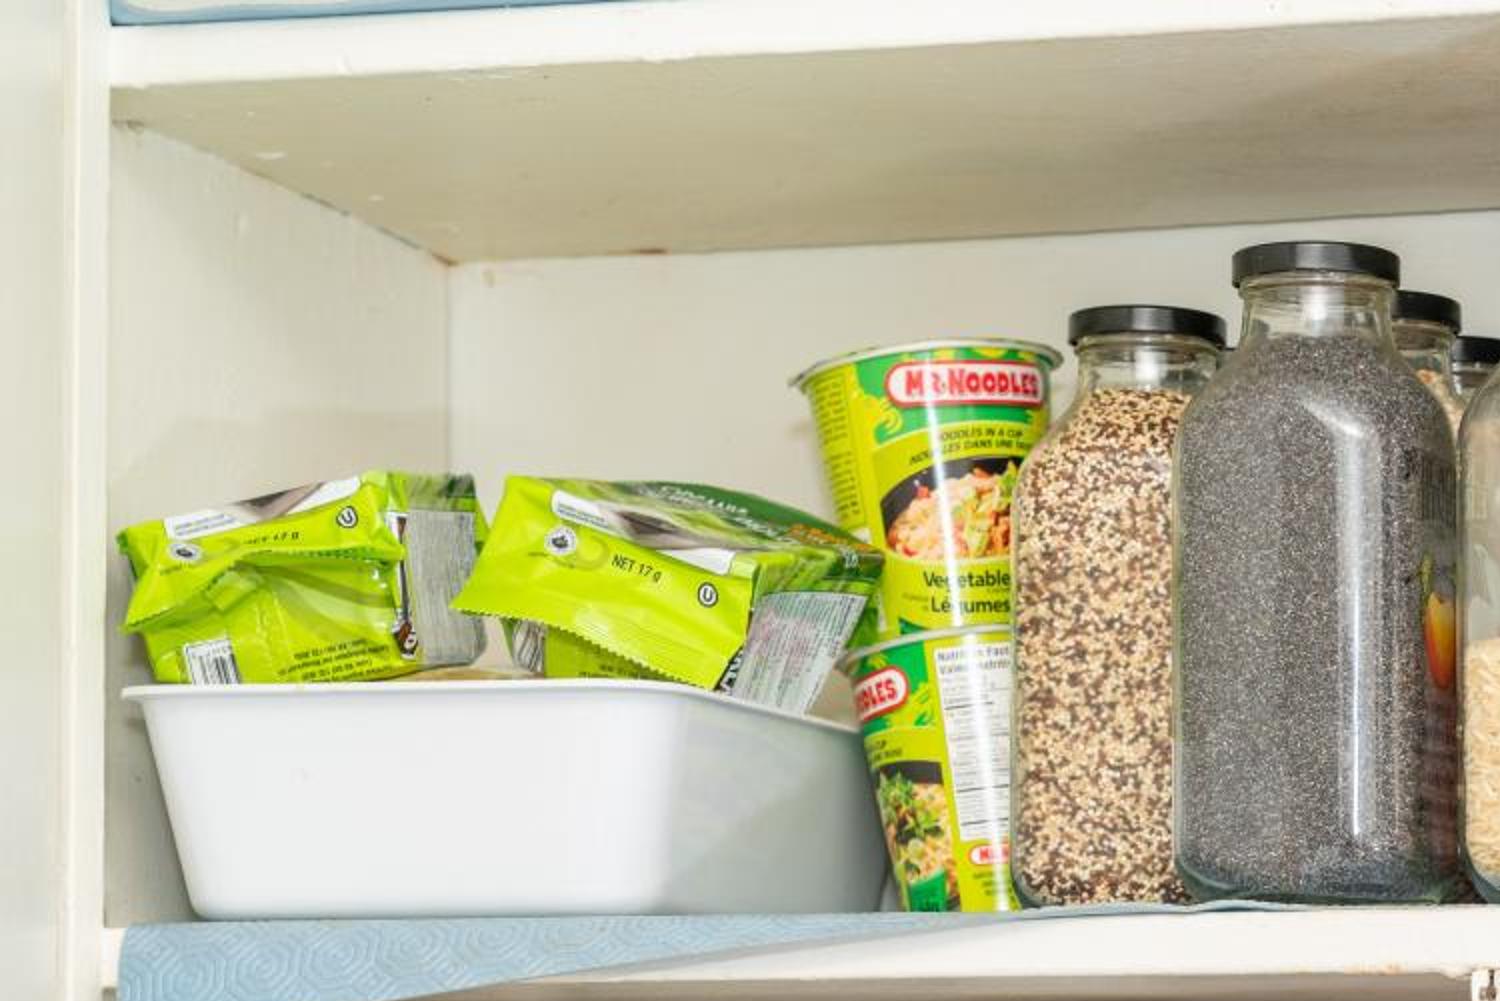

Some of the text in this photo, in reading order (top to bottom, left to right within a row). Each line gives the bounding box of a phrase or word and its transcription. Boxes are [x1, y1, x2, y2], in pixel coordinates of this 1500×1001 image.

[949, 368, 1040, 397] NOODLES
[611, 554, 635, 573] NET
[931, 594, 1011, 615] Léumes
